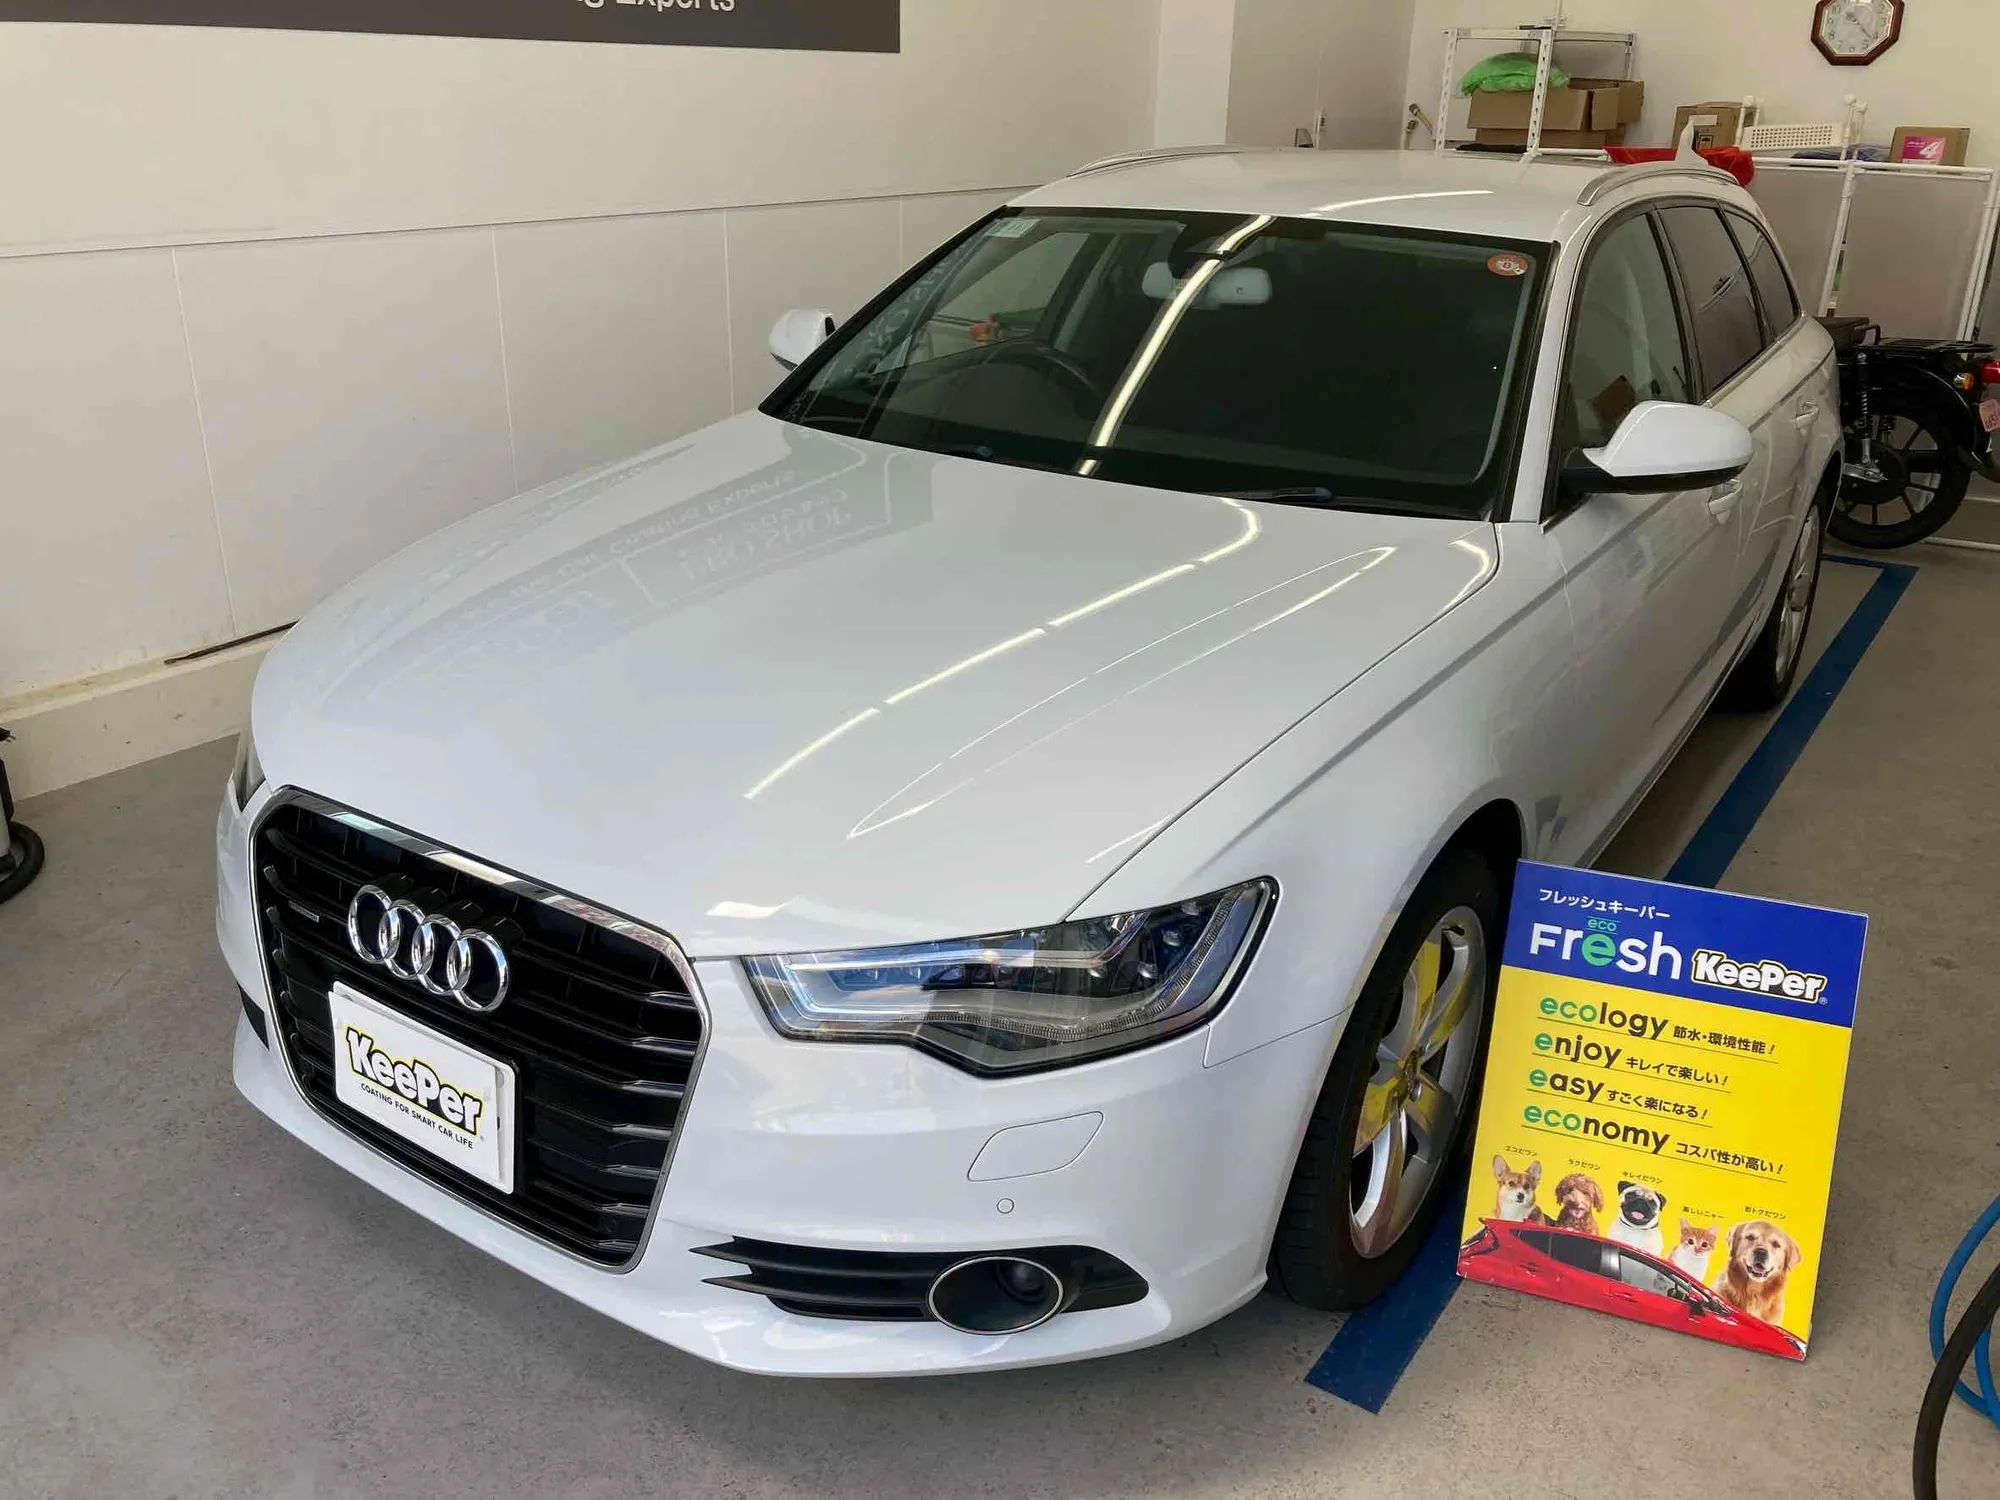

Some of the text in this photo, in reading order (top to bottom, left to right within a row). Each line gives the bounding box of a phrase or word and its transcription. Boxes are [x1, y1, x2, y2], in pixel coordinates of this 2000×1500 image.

[1587, 918, 1617, 932] eco
[1530, 922, 1827, 1004] Fresh KeePer
[1540, 997, 1668, 1037] ecology
[1534, 1032, 1621, 1069] enjoy
[346, 1026, 483, 1136] KeePer
[1529, 1069, 1604, 1103] easy
[360, 1082, 474, 1149] COATING FOR SMART CAR LIFE
[1524, 1104, 1670, 1155] economy
